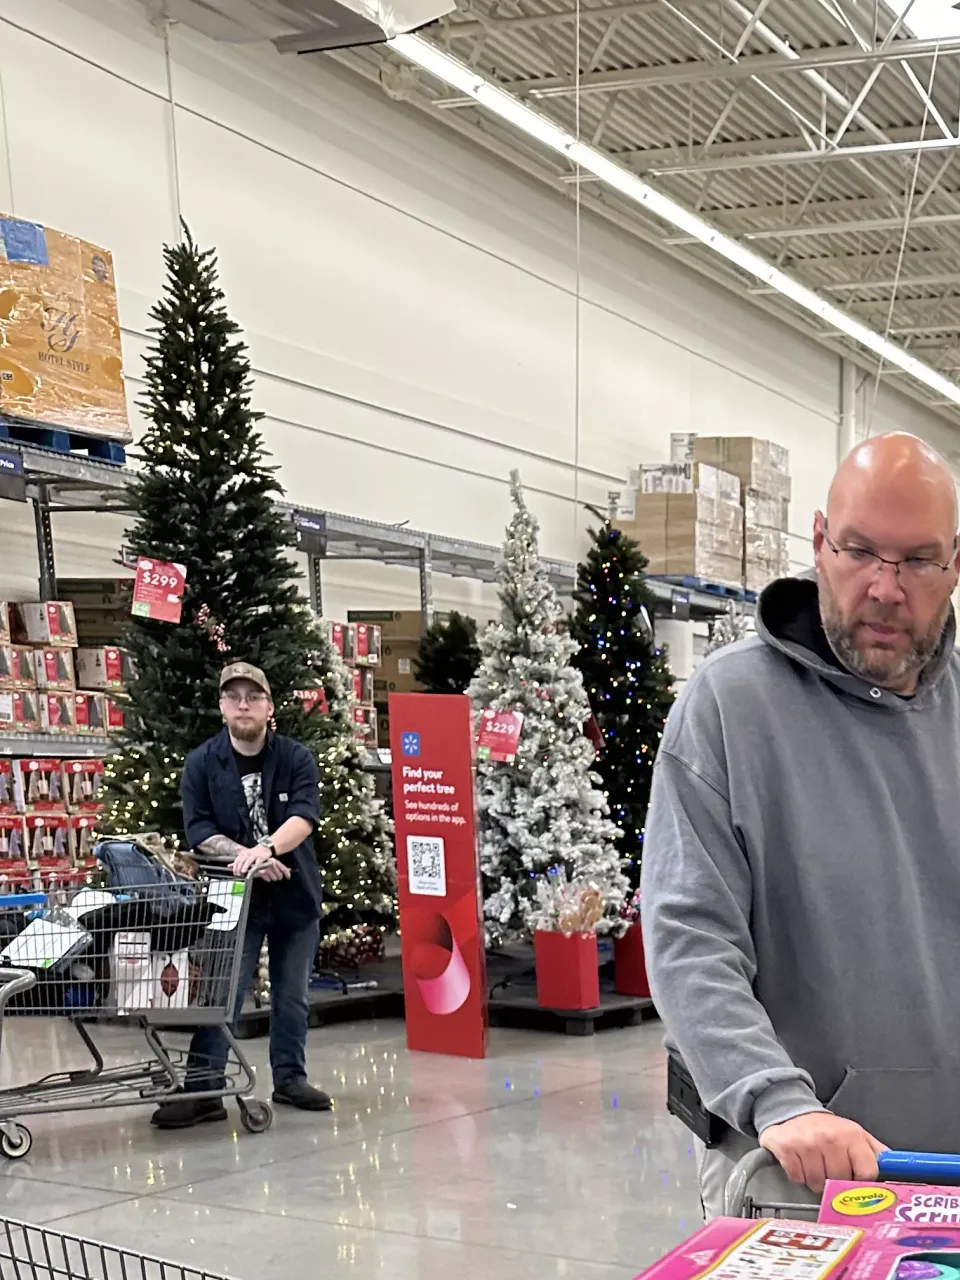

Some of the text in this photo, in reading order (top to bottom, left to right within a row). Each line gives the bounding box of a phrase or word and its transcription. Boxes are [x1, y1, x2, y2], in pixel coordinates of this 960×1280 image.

[38, 351, 91, 373] HOTEL STYLE
[142, 571, 178, 589] $299
[485, 720, 516, 735] $229
[402, 765, 443, 782] Find your
[403, 781, 456, 796] perfect tree
[404, 799, 460, 812] See hundreds of
[405, 812, 467, 826] options in the app.
[842, 1192, 885, 1203] Crayola
